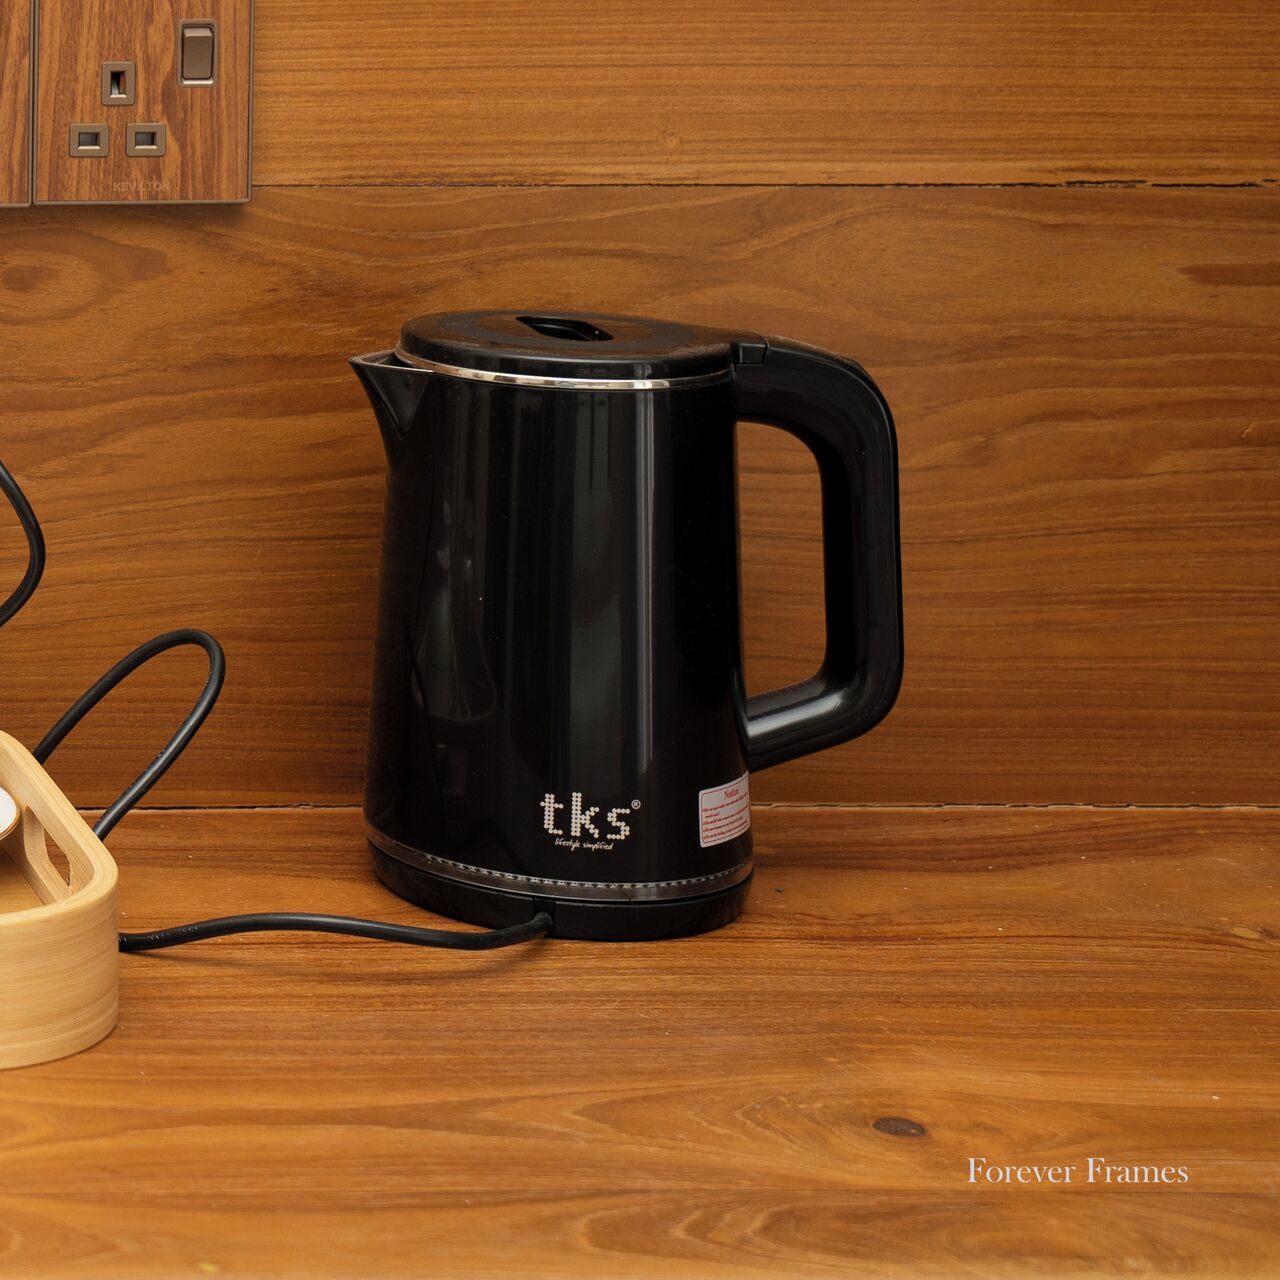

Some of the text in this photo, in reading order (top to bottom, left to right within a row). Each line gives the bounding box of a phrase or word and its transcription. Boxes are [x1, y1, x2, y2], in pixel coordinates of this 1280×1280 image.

[539, 791, 631, 840] tks
[555, 837, 614, 851] lifestyle simplified
